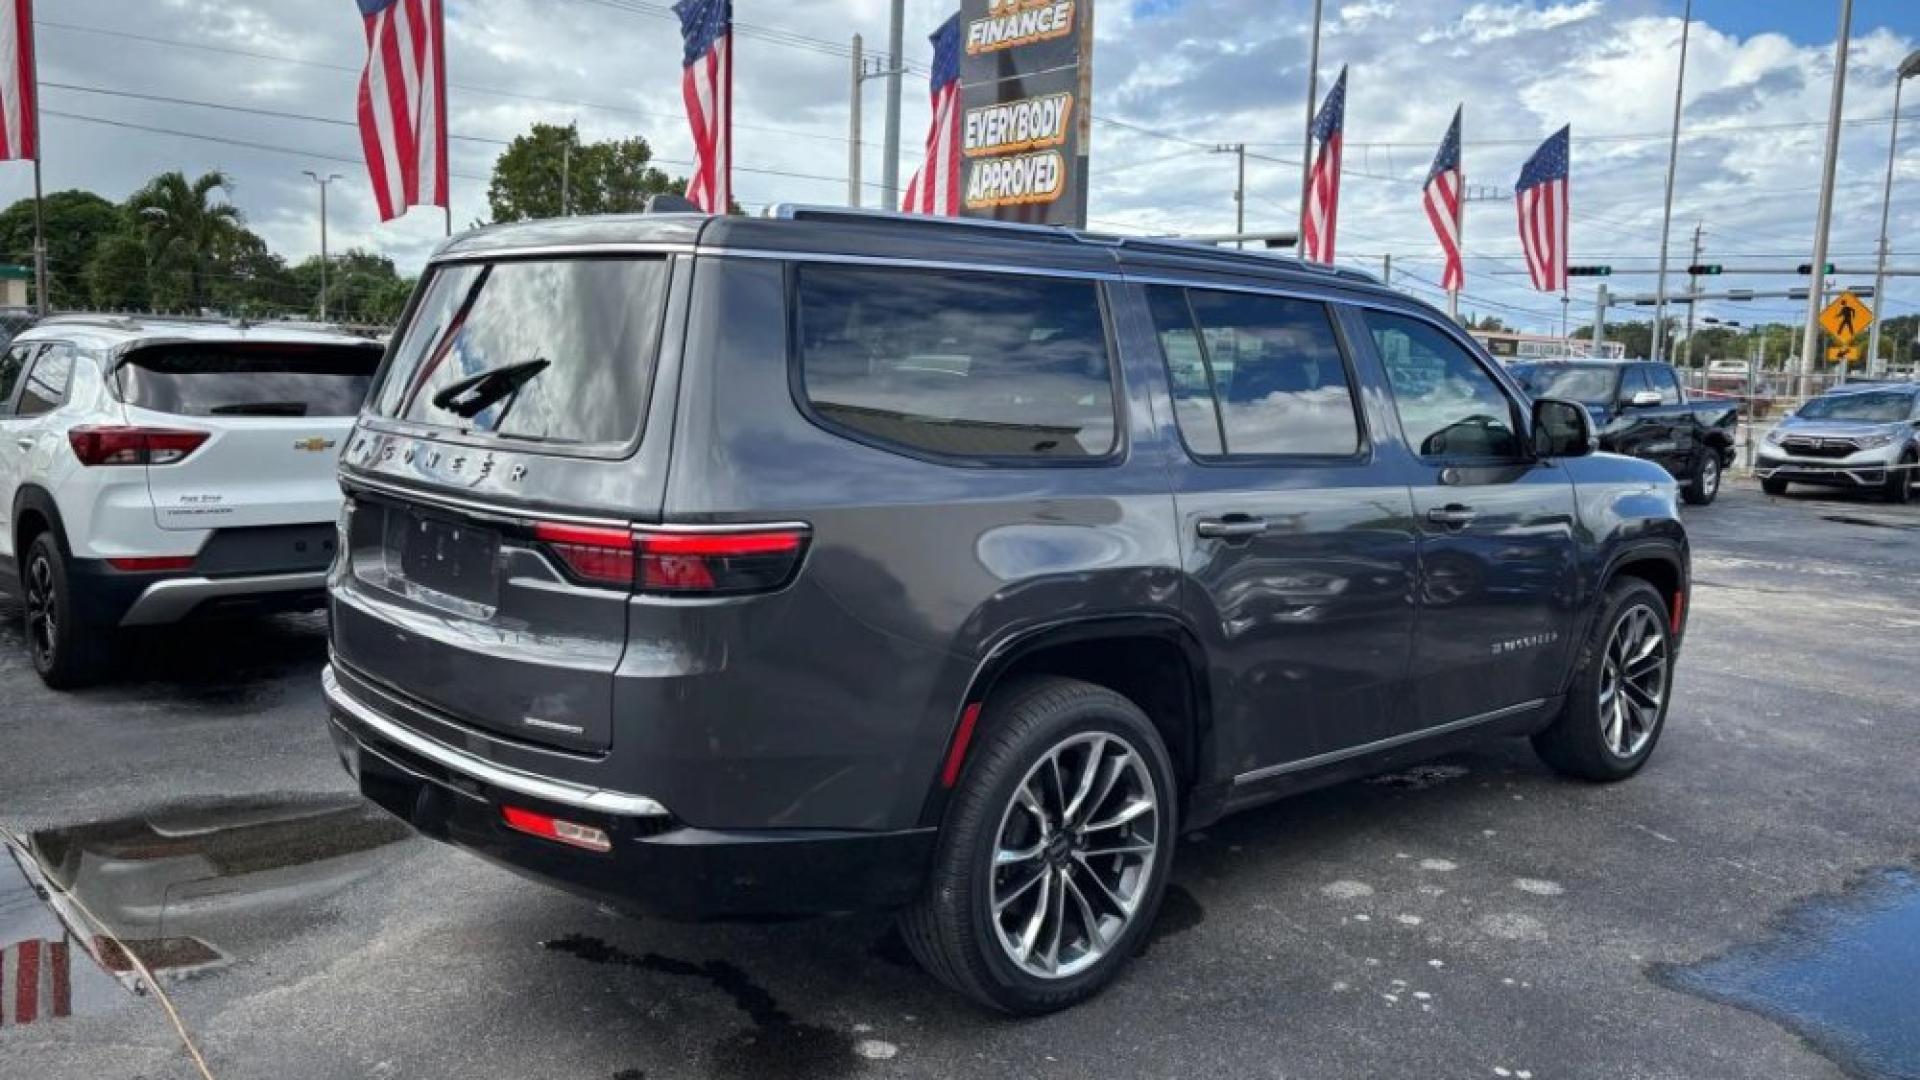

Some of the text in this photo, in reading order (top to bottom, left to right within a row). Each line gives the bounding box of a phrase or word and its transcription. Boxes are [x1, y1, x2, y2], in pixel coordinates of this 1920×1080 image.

[968, 3, 1071, 46] FINANCE
[966, 96, 1067, 148] EVERYBODY
[968, 153, 1058, 200] APPROVED
